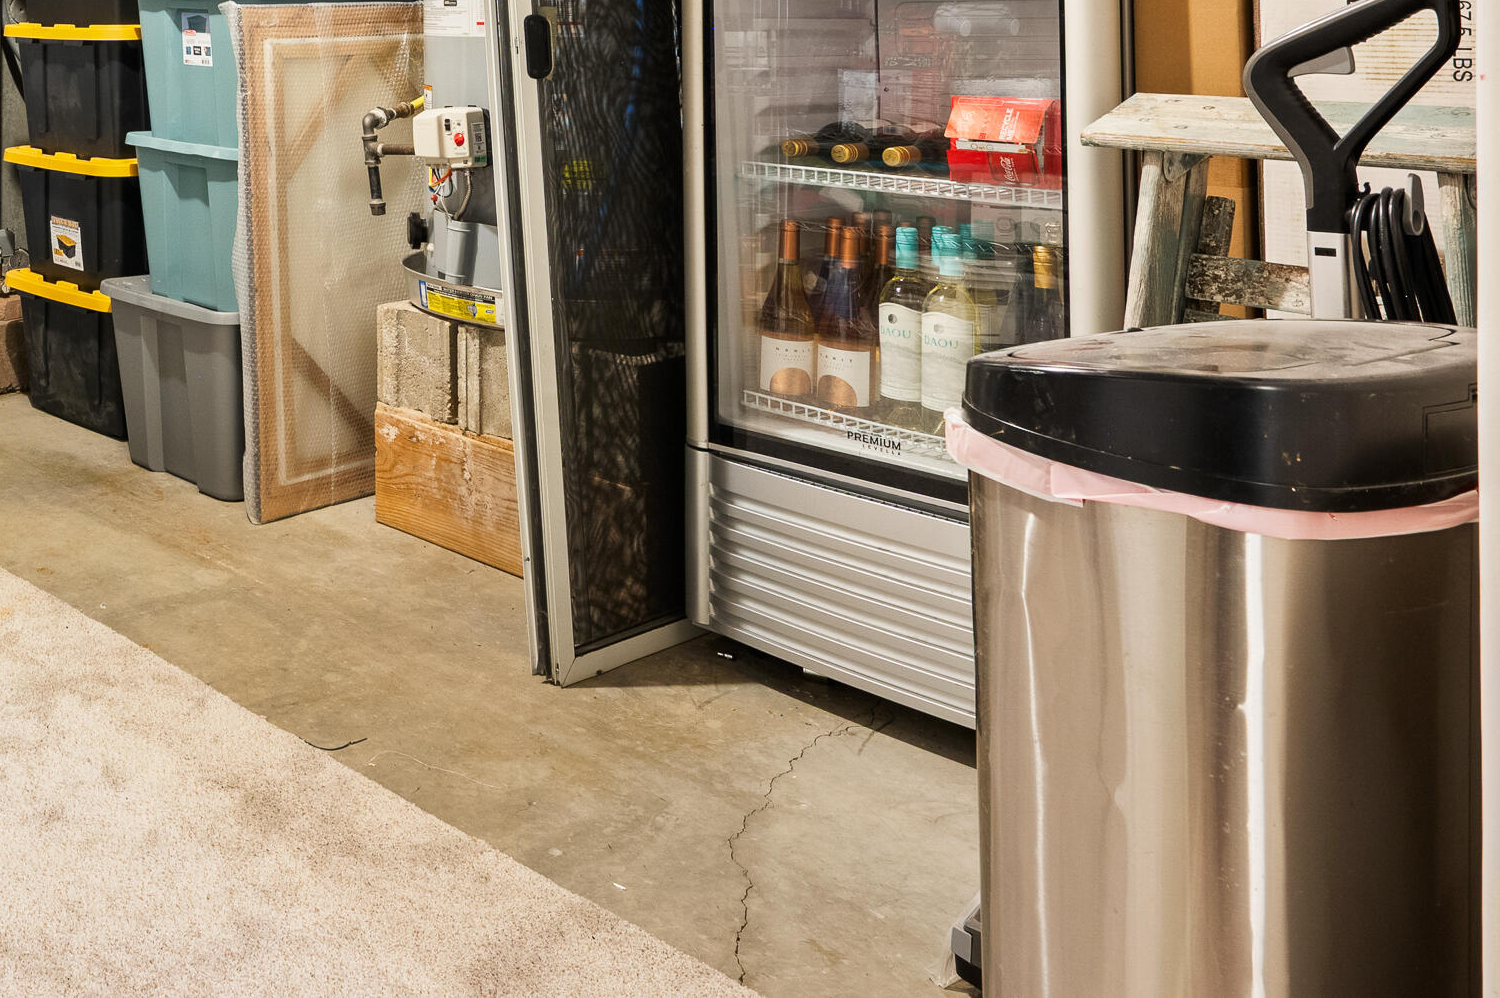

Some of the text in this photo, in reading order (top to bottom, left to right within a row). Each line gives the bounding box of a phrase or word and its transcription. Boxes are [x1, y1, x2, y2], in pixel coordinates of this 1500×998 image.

[880, 325, 912, 339] DAOU
[924, 333, 959, 350] DAOU
[847, 430, 901, 451] PREMIUM
